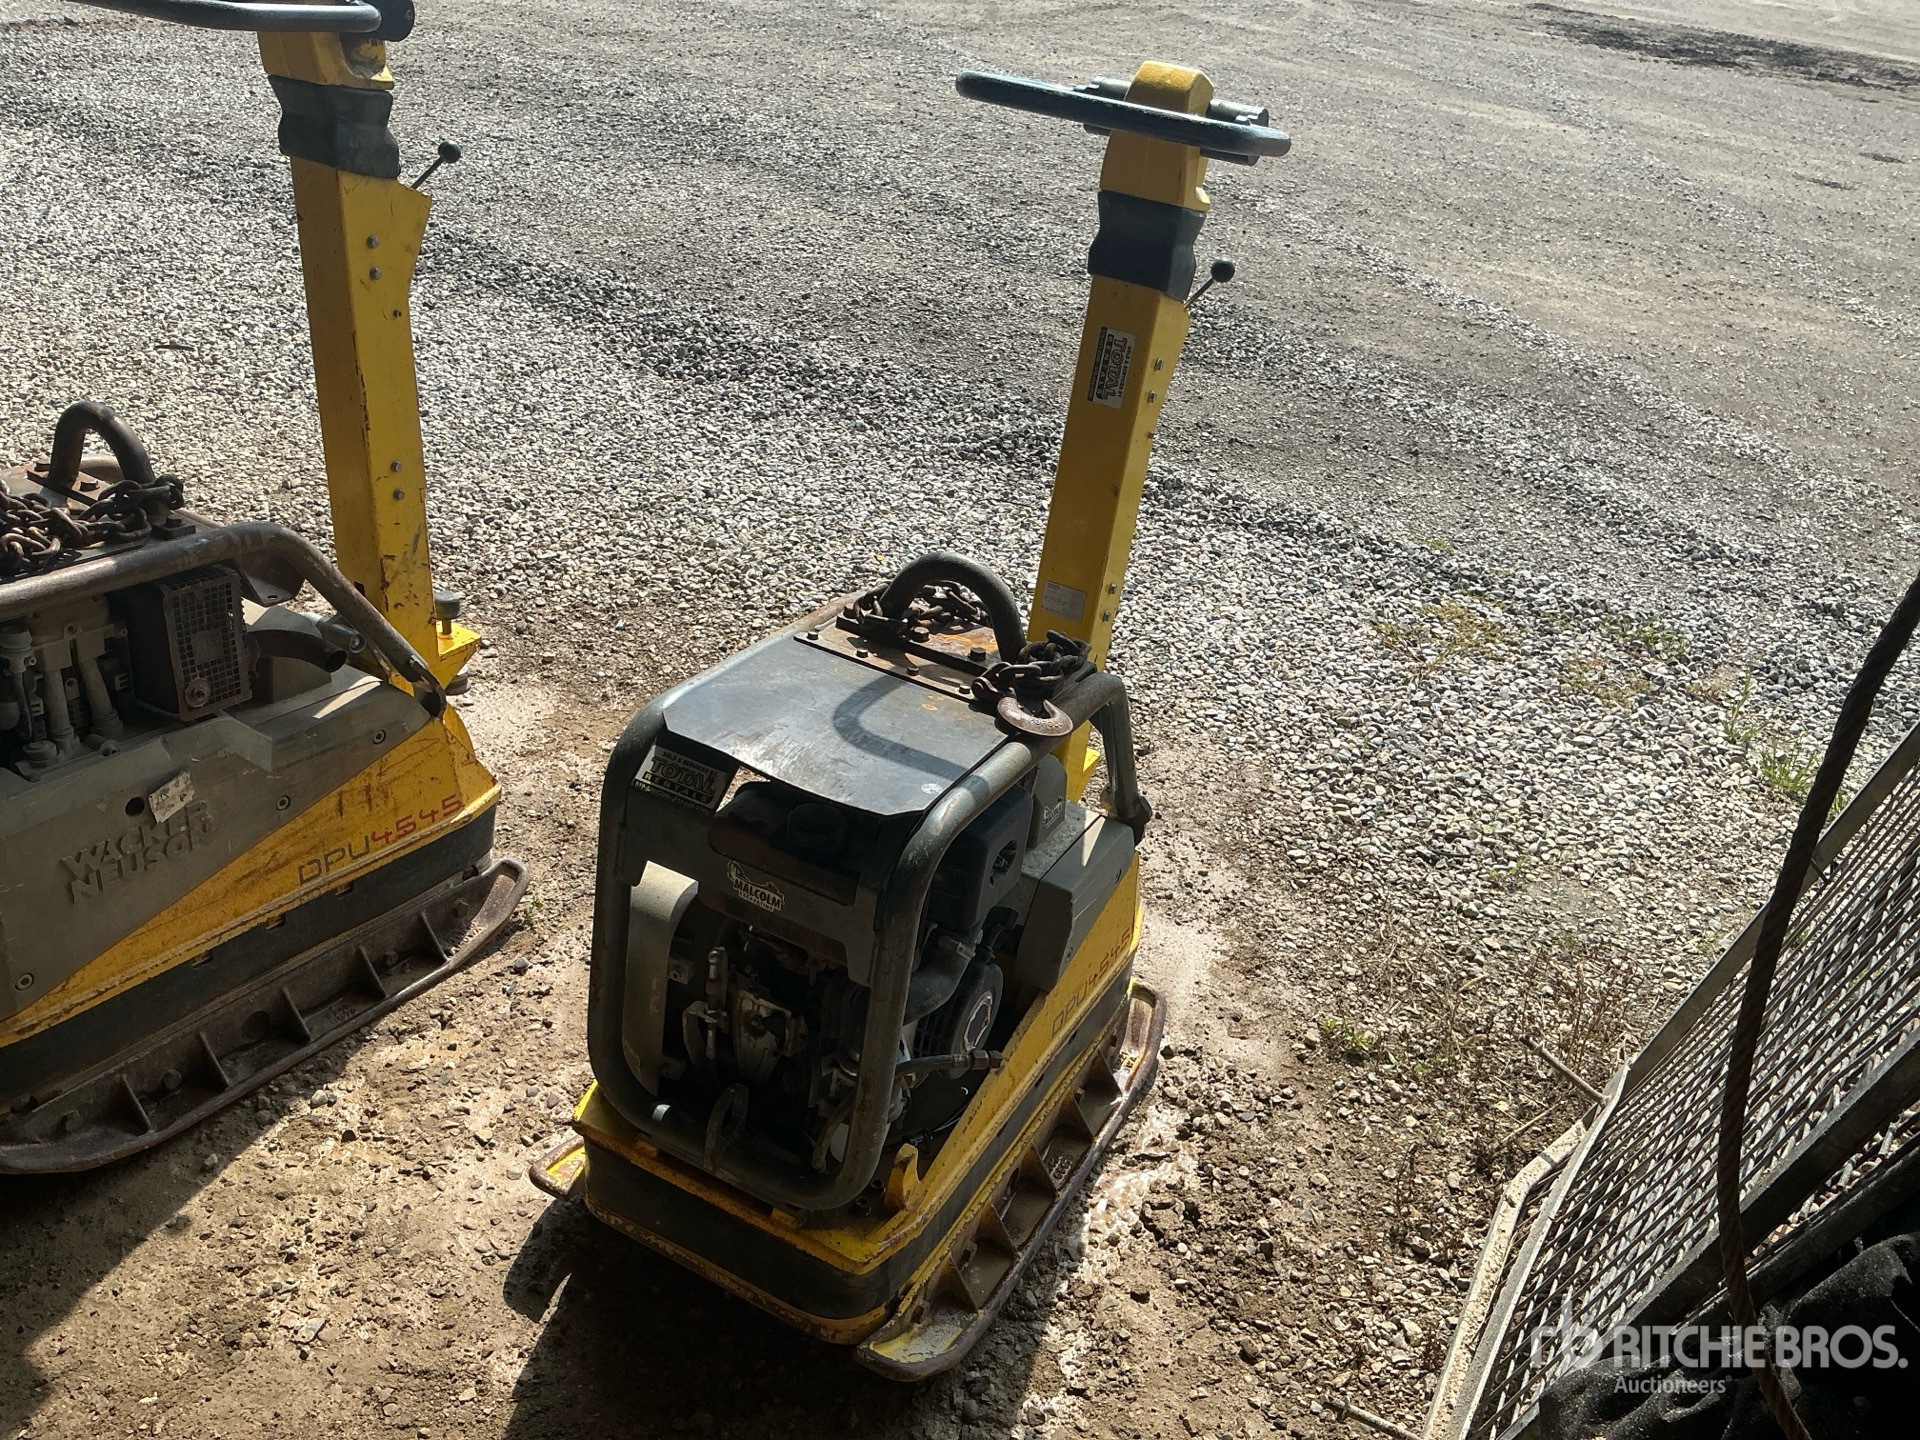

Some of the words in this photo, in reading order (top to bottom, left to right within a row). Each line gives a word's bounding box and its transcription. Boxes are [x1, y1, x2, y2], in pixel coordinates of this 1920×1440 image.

[1097, 335, 1113, 397] RENTALS
[1103, 337, 1127, 400] TOTAL
[644, 772, 709, 803] RENTALS
[650, 757, 718, 796] TOTAL
[662, 751, 679, 762] SOLD
[682, 759, 709, 774] SERVICED
[68, 819, 212, 903] NEUSON
[297, 793, 464, 885] DPU4545
[733, 879, 782, 908] MALCOLM
[738, 891, 774, 912] EXCAVATING
[1051, 927, 1132, 1038] DPU4545
